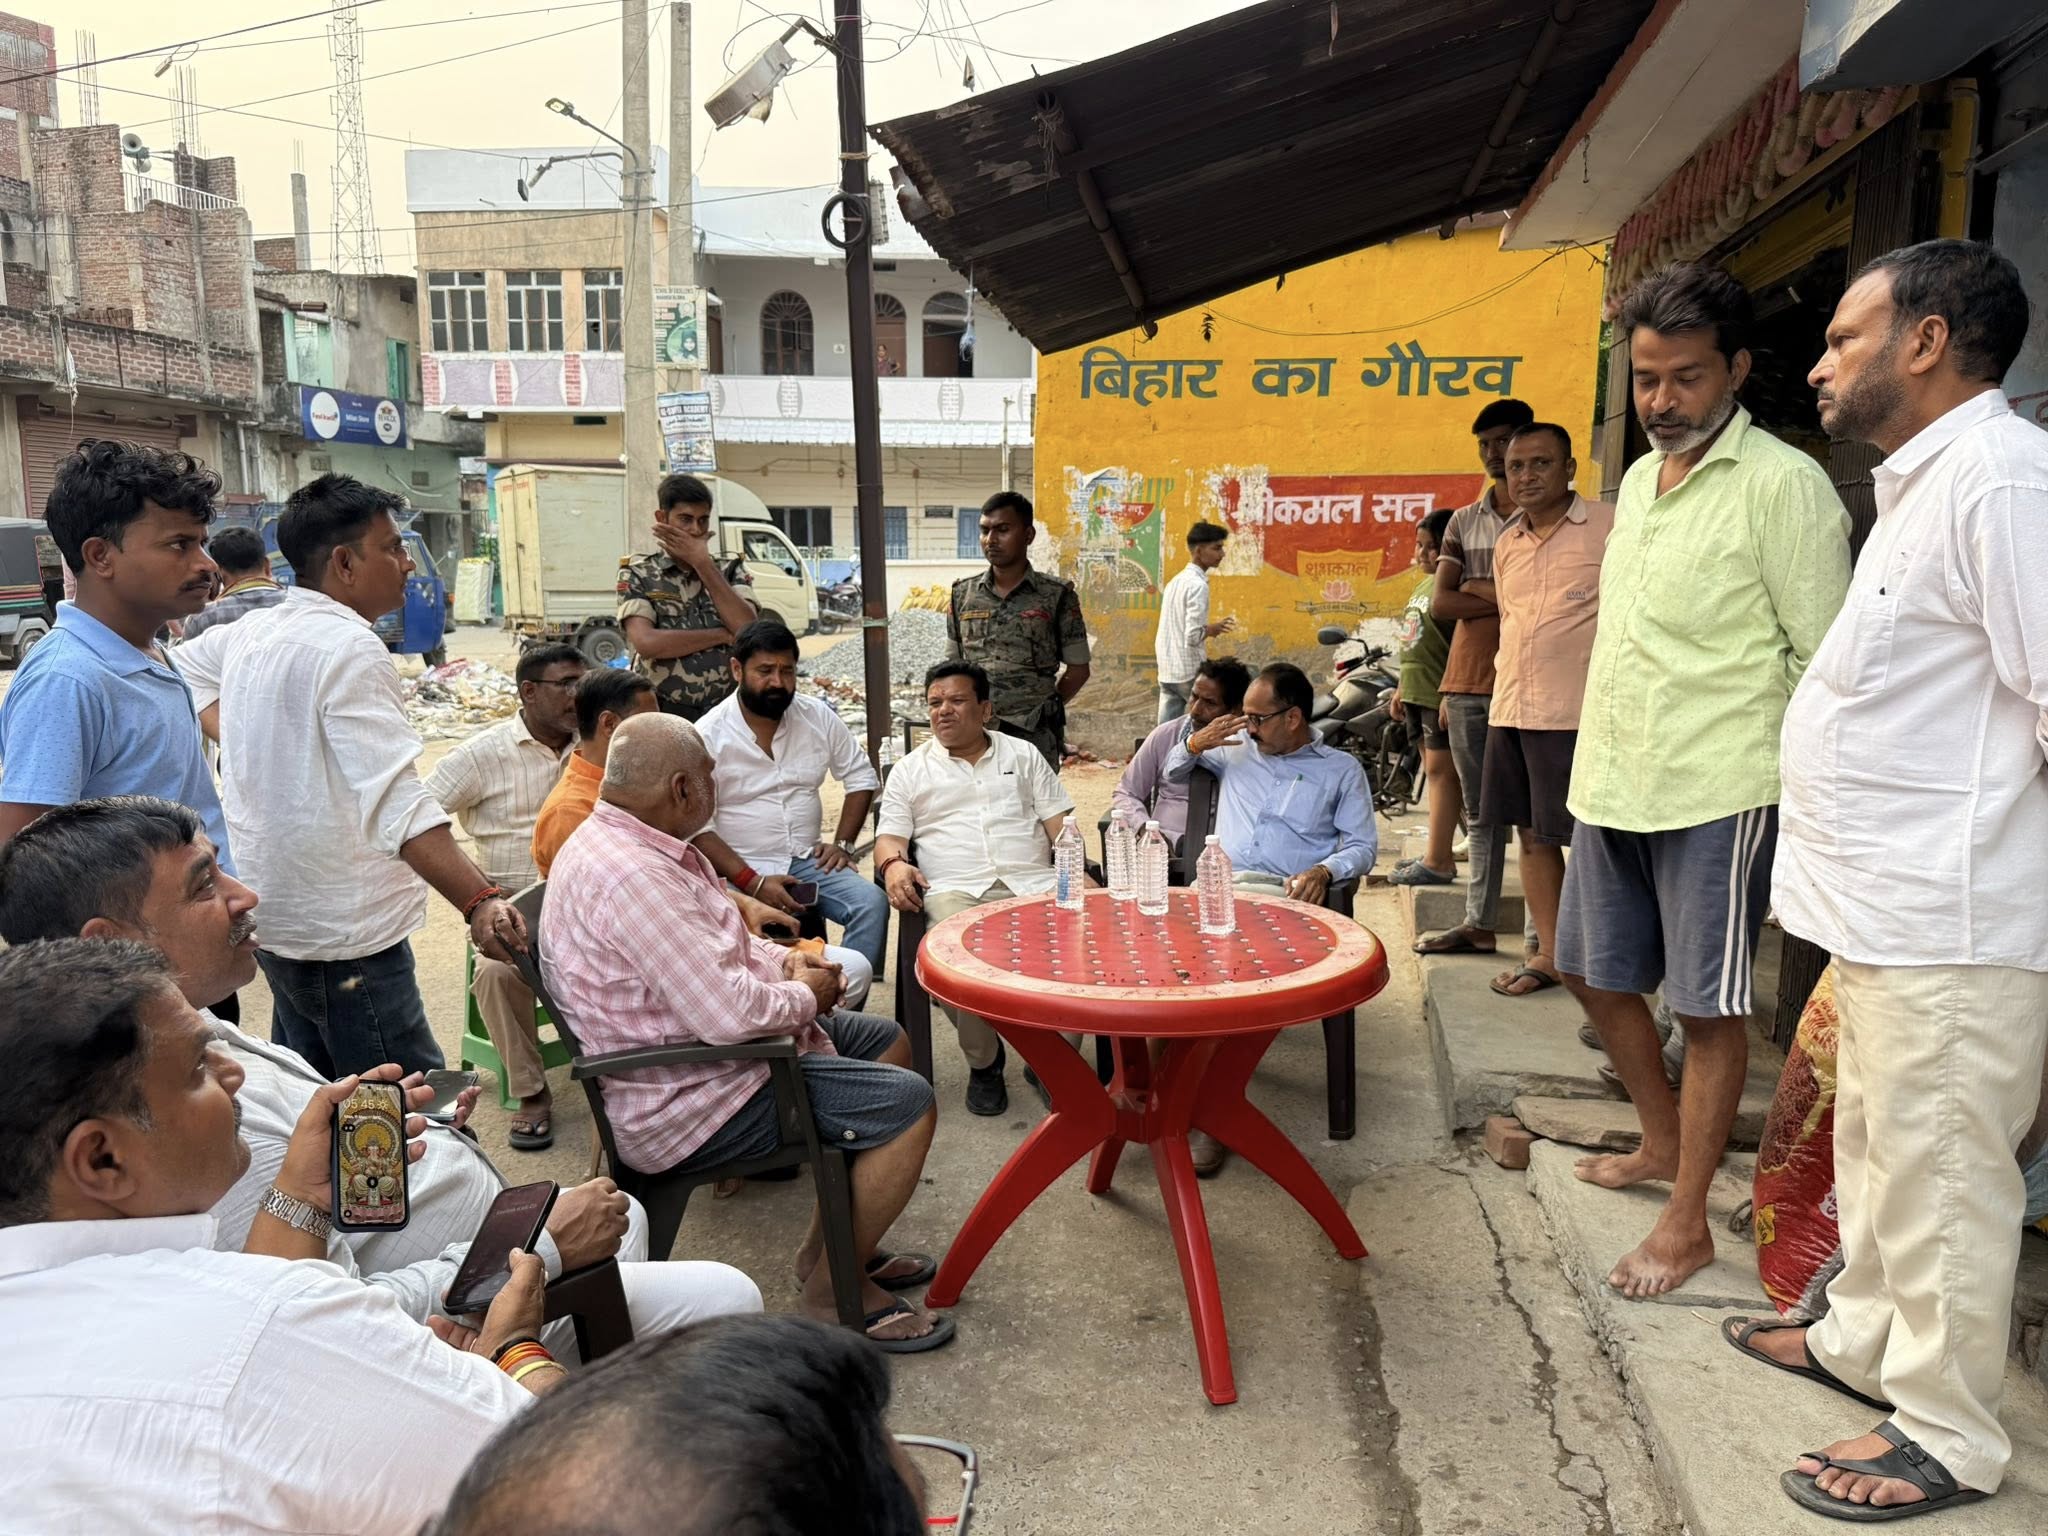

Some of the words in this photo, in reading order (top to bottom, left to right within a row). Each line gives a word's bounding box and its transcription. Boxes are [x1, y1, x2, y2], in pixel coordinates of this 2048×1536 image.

[1079, 345, 1223, 406] बिहार
[1251, 357, 1337, 398] का
[1360, 339, 1523, 397] गौरव
